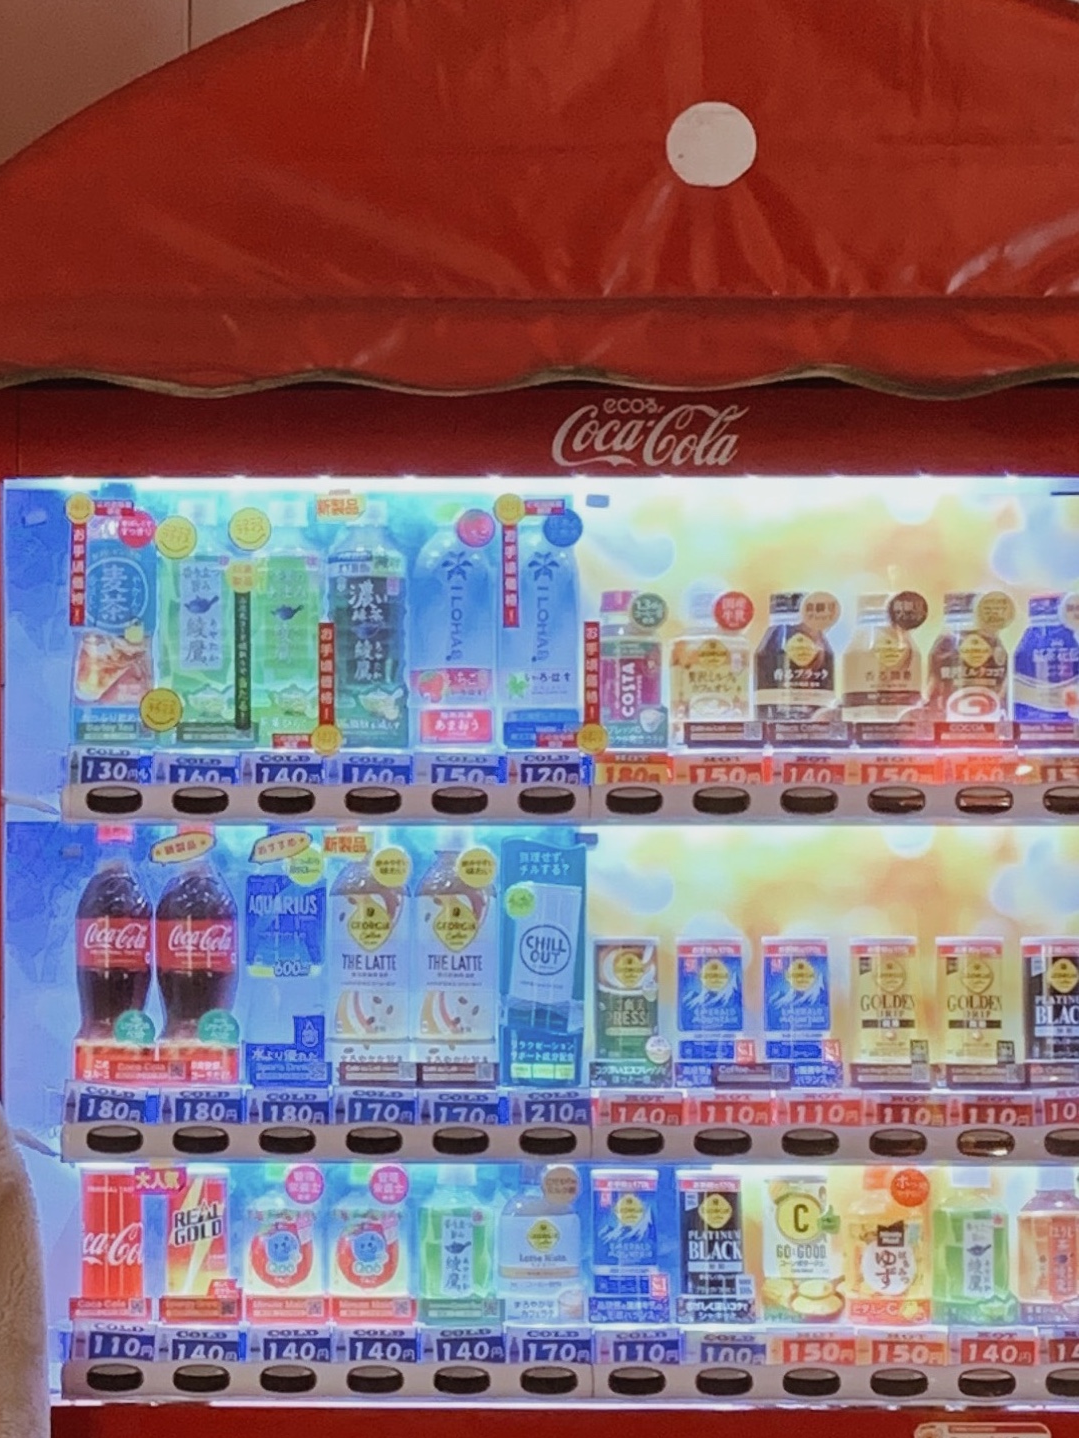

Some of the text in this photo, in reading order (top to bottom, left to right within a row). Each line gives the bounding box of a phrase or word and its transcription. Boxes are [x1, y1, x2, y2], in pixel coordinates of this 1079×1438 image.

[552, 404, 750, 467] Coca-Cola
[100, 563, 129, 622] 麦茶
[348, 579, 388, 609] 濃い
[774, 669, 829, 681] 香るブラック
[622, 662, 635, 718] COSTA
[435, 718, 479, 732] あまおう
[950, 723, 986, 732] COCOA
[86, 747, 131, 757] COLD
[259, 754, 311, 763] COLD
[349, 756, 395, 764] COLD
[435, 755, 488, 763] COLD
[176, 757, 222, 766] COLD
[324, 835, 367, 853] 新製品
[520, 863, 570, 876] チルする?
[249, 894, 318, 915] AQUARIUS
[83, 922, 148, 950] Coca-Cola
[169, 924, 234, 951] Coca-Cola
[525, 935, 567, 953] CHILL
[342, 954, 397, 971] THE LATTE
[428, 954, 483, 971] THE LATTE
[530, 949, 561, 966] OUT
[86, 1086, 135, 1098] COLD
[179, 1090, 231, 1099] COLD
[267, 1092, 318, 1101] COLD
[352, 1089, 404, 1098] COLD
[438, 1093, 489, 1102] COLD
[528, 1090, 580, 1100] COLD
[87, 1099, 141, 1121] 180円
[183, 1101, 238, 1121] 180円
[271, 1105, 325, 1124] 180円
[354, 1102, 414, 1123] 170円
[531, 1103, 588, 1123] 210円
[618, 1107, 680, 1125] 140円
[706, 1106, 769, 1124] 110円
[135, 1172, 181, 1190] 大人気
[174, 1205, 222, 1229] REAL
[793, 1203, 809, 1234] C
[174, 1218, 223, 1247] GOLD
[688, 1241, 742, 1261] BLACK
[269, 1263, 294, 1273] Qoo
[354, 1263, 381, 1274] Qoo
[875, 1250, 897, 1290] ゆず
[852, 1301, 898, 1315] ビタミンC
[94, 1322, 145, 1333] COLD
[175, 1330, 227, 1339] COLD
[268, 1329, 319, 1337] COLD
[353, 1329, 406, 1337] COLD
[440, 1328, 492, 1338] COLD
[526, 1330, 580, 1338] COLD
[615, 1331, 667, 1339] COLD
[94, 1335, 153, 1357] 110円
[270, 1342, 329, 1361] 140円
[356, 1342, 416, 1361] 140円
[442, 1341, 506, 1361] 140円
[528, 1343, 591, 1362] 170円
[969, 1342, 1032, 1362] 140円
